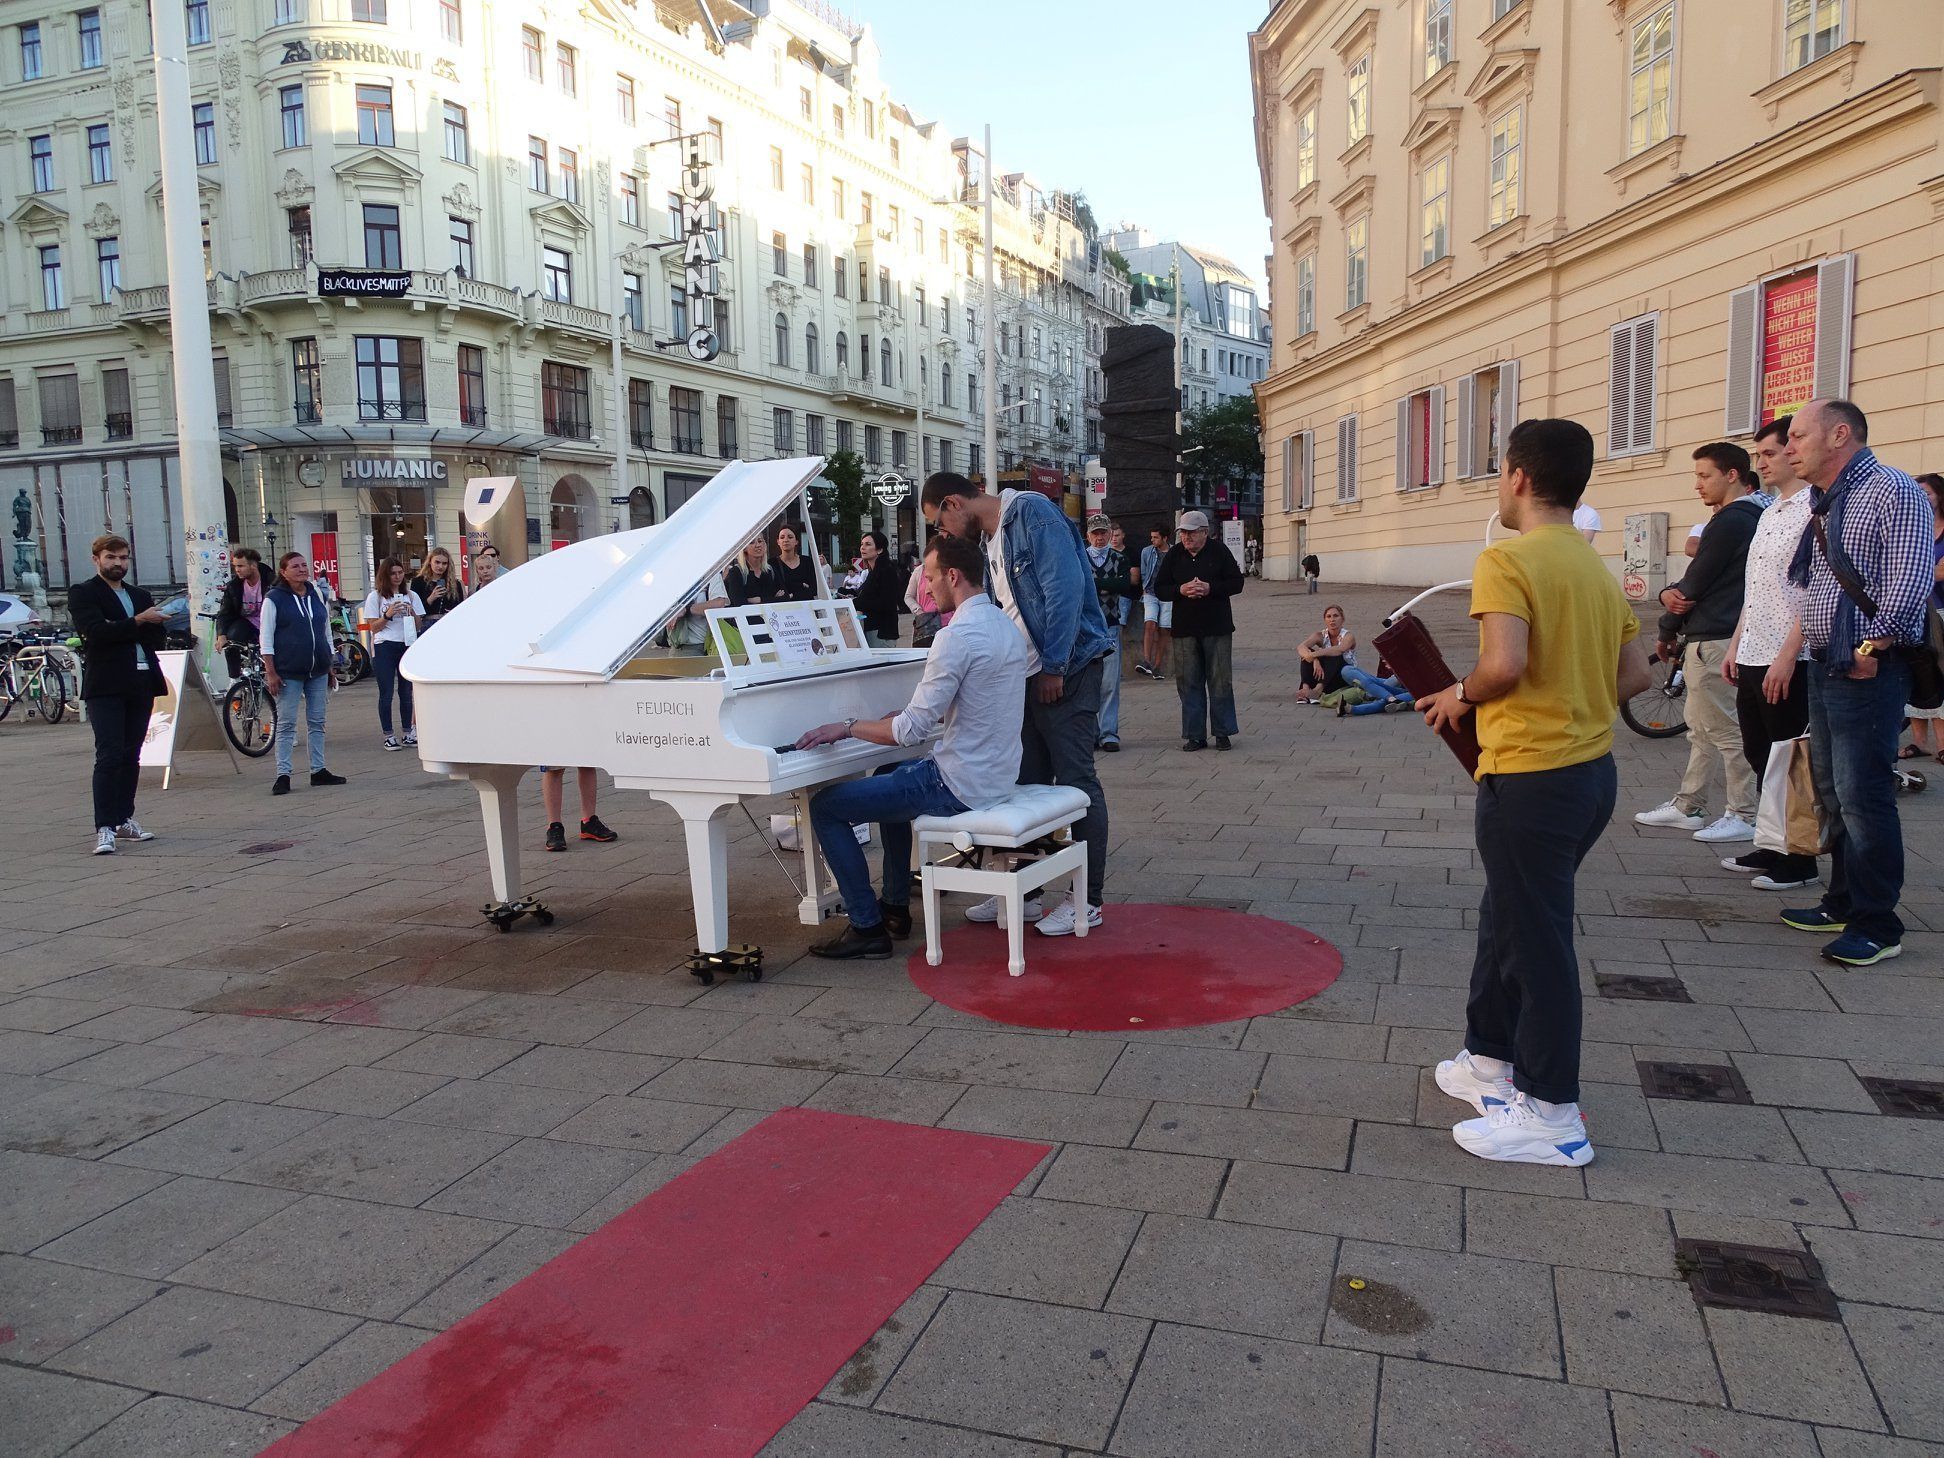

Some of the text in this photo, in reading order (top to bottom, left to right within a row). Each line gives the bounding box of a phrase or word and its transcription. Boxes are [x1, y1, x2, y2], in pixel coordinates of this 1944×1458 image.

[682, 134, 720, 361] HUMANIC
[1773, 292, 1801, 314] WENN
[1768, 313, 1795, 335] NICHT
[1778, 328, 1813, 350] WEITER
[1781, 347, 1809, 367] WISST
[1767, 388, 1793, 407] PLACE
[342, 460, 446, 479] HUMANIC
[873, 483, 909, 494] young style
[468, 531, 488, 539] DRINK
[313, 560, 338, 573] SALE
[636, 701, 695, 716] FEURICH
[615, 731, 711, 748] klaviergalerie.at
